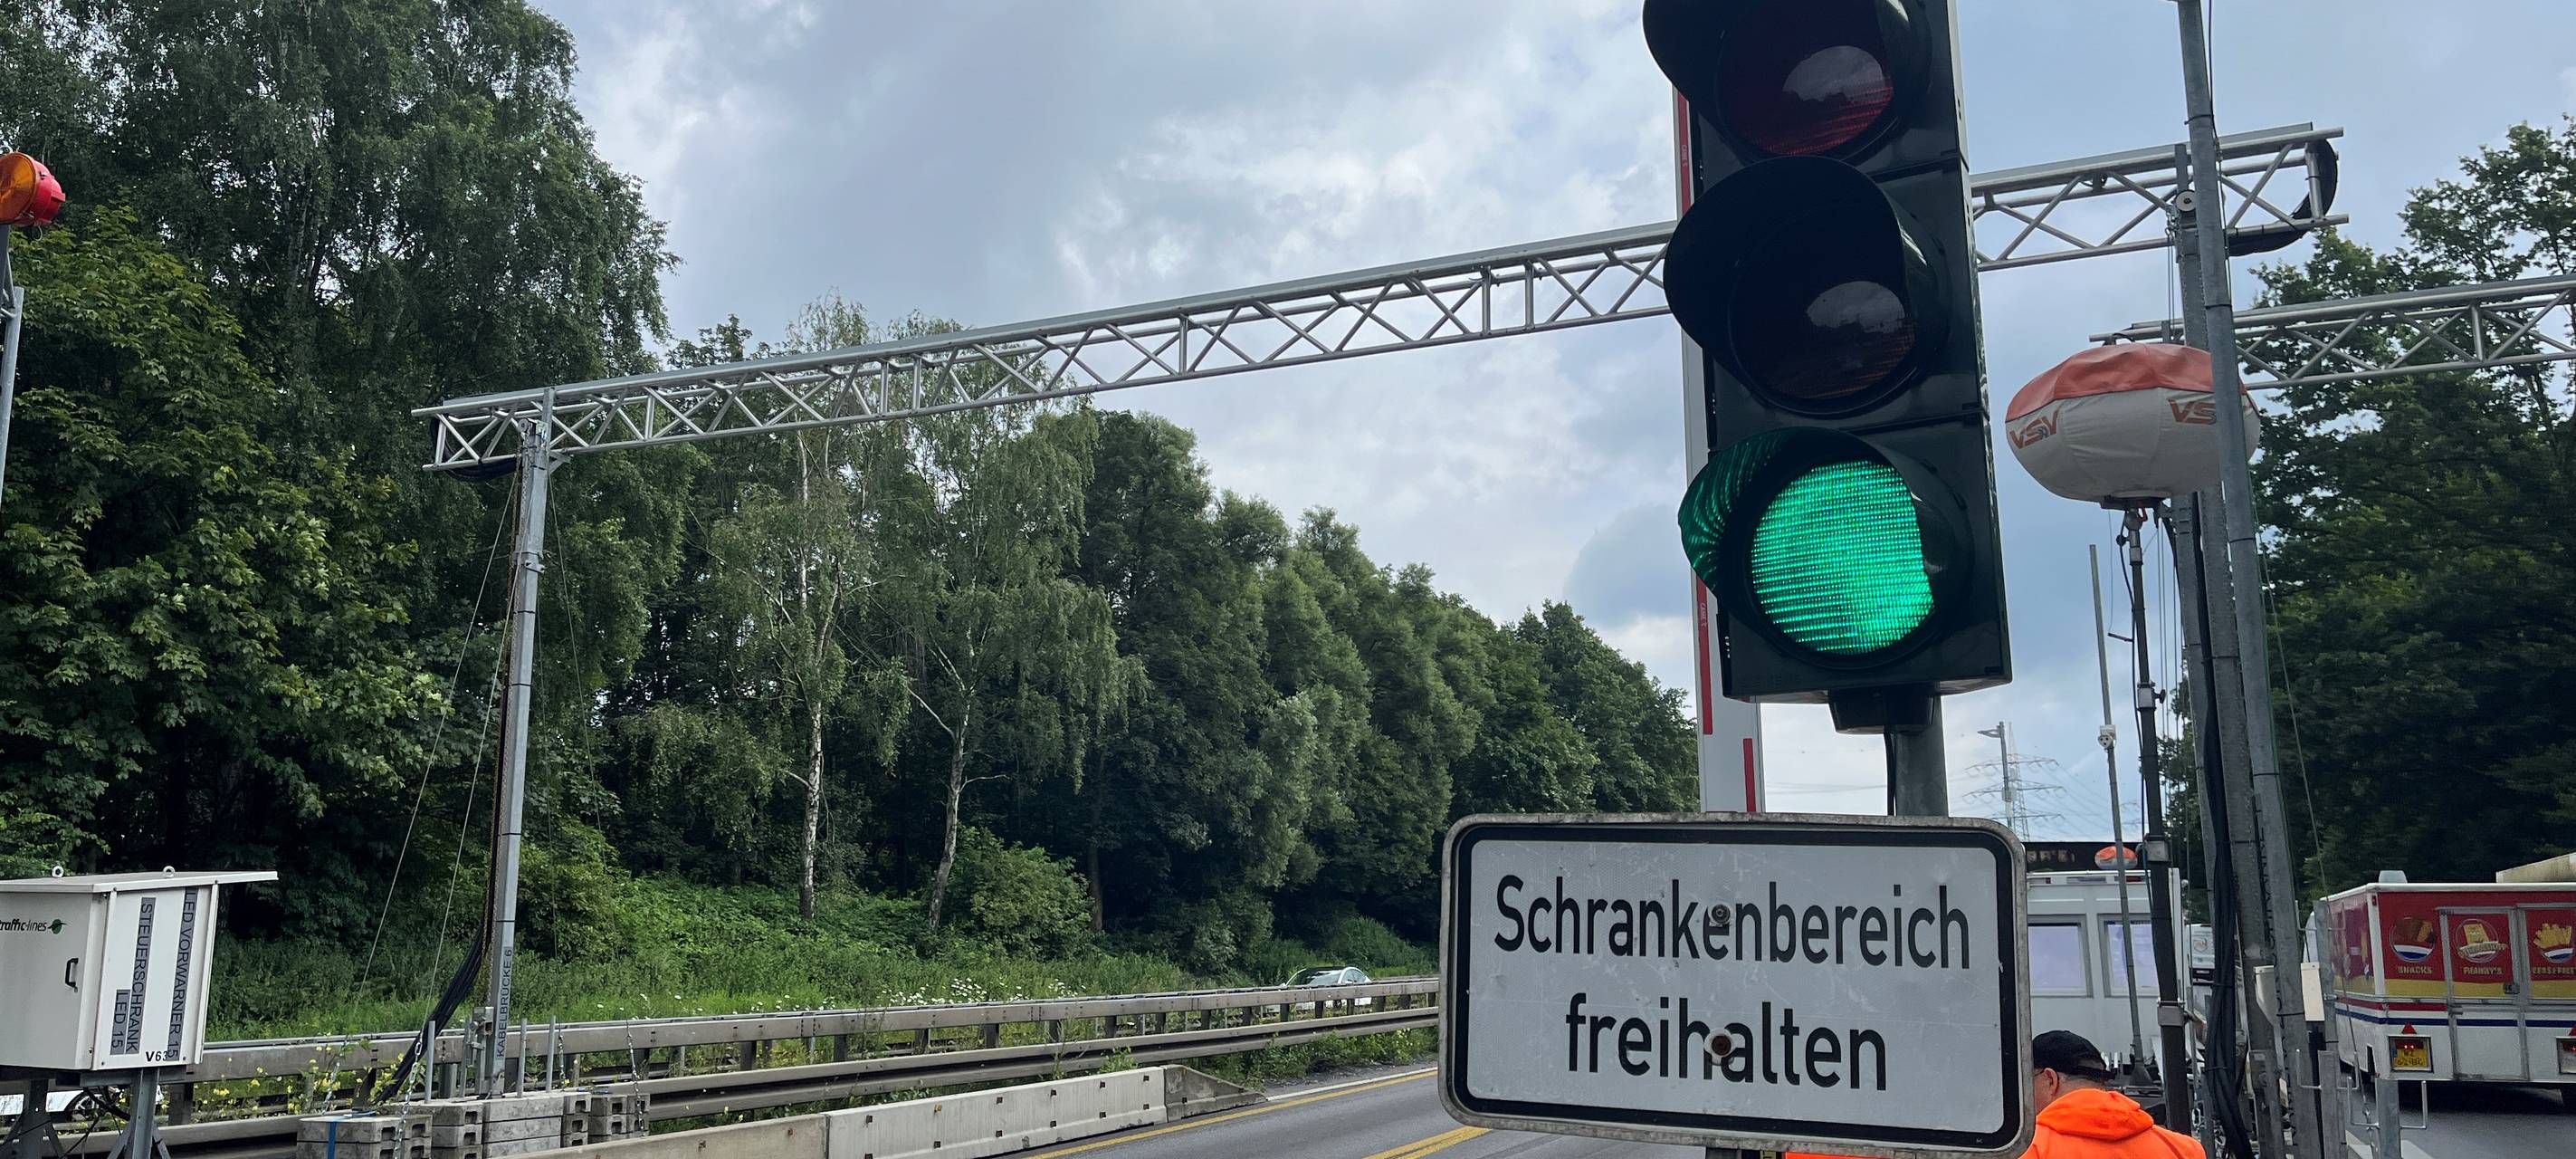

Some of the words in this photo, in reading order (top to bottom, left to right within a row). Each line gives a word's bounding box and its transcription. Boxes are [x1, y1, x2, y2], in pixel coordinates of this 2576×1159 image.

[2009, 409, 2059, 449] VSV
[2167, 398, 2217, 425] VS
[183, 892, 196, 923] LED
[1493, 874, 1970, 970] Schrankenbereich
[504, 949, 513, 957] 6
[126, 904, 154, 1053] STEUERSCHRANK
[169, 928, 192, 1034] VORWARNER
[114, 992, 129, 1024] LED
[497, 961, 512, 1057] KABELBRÜCKE
[111, 1030, 124, 1048] 15
[167, 1041, 179, 1058] 15
[1565, 992, 1887, 1091] freihalten
